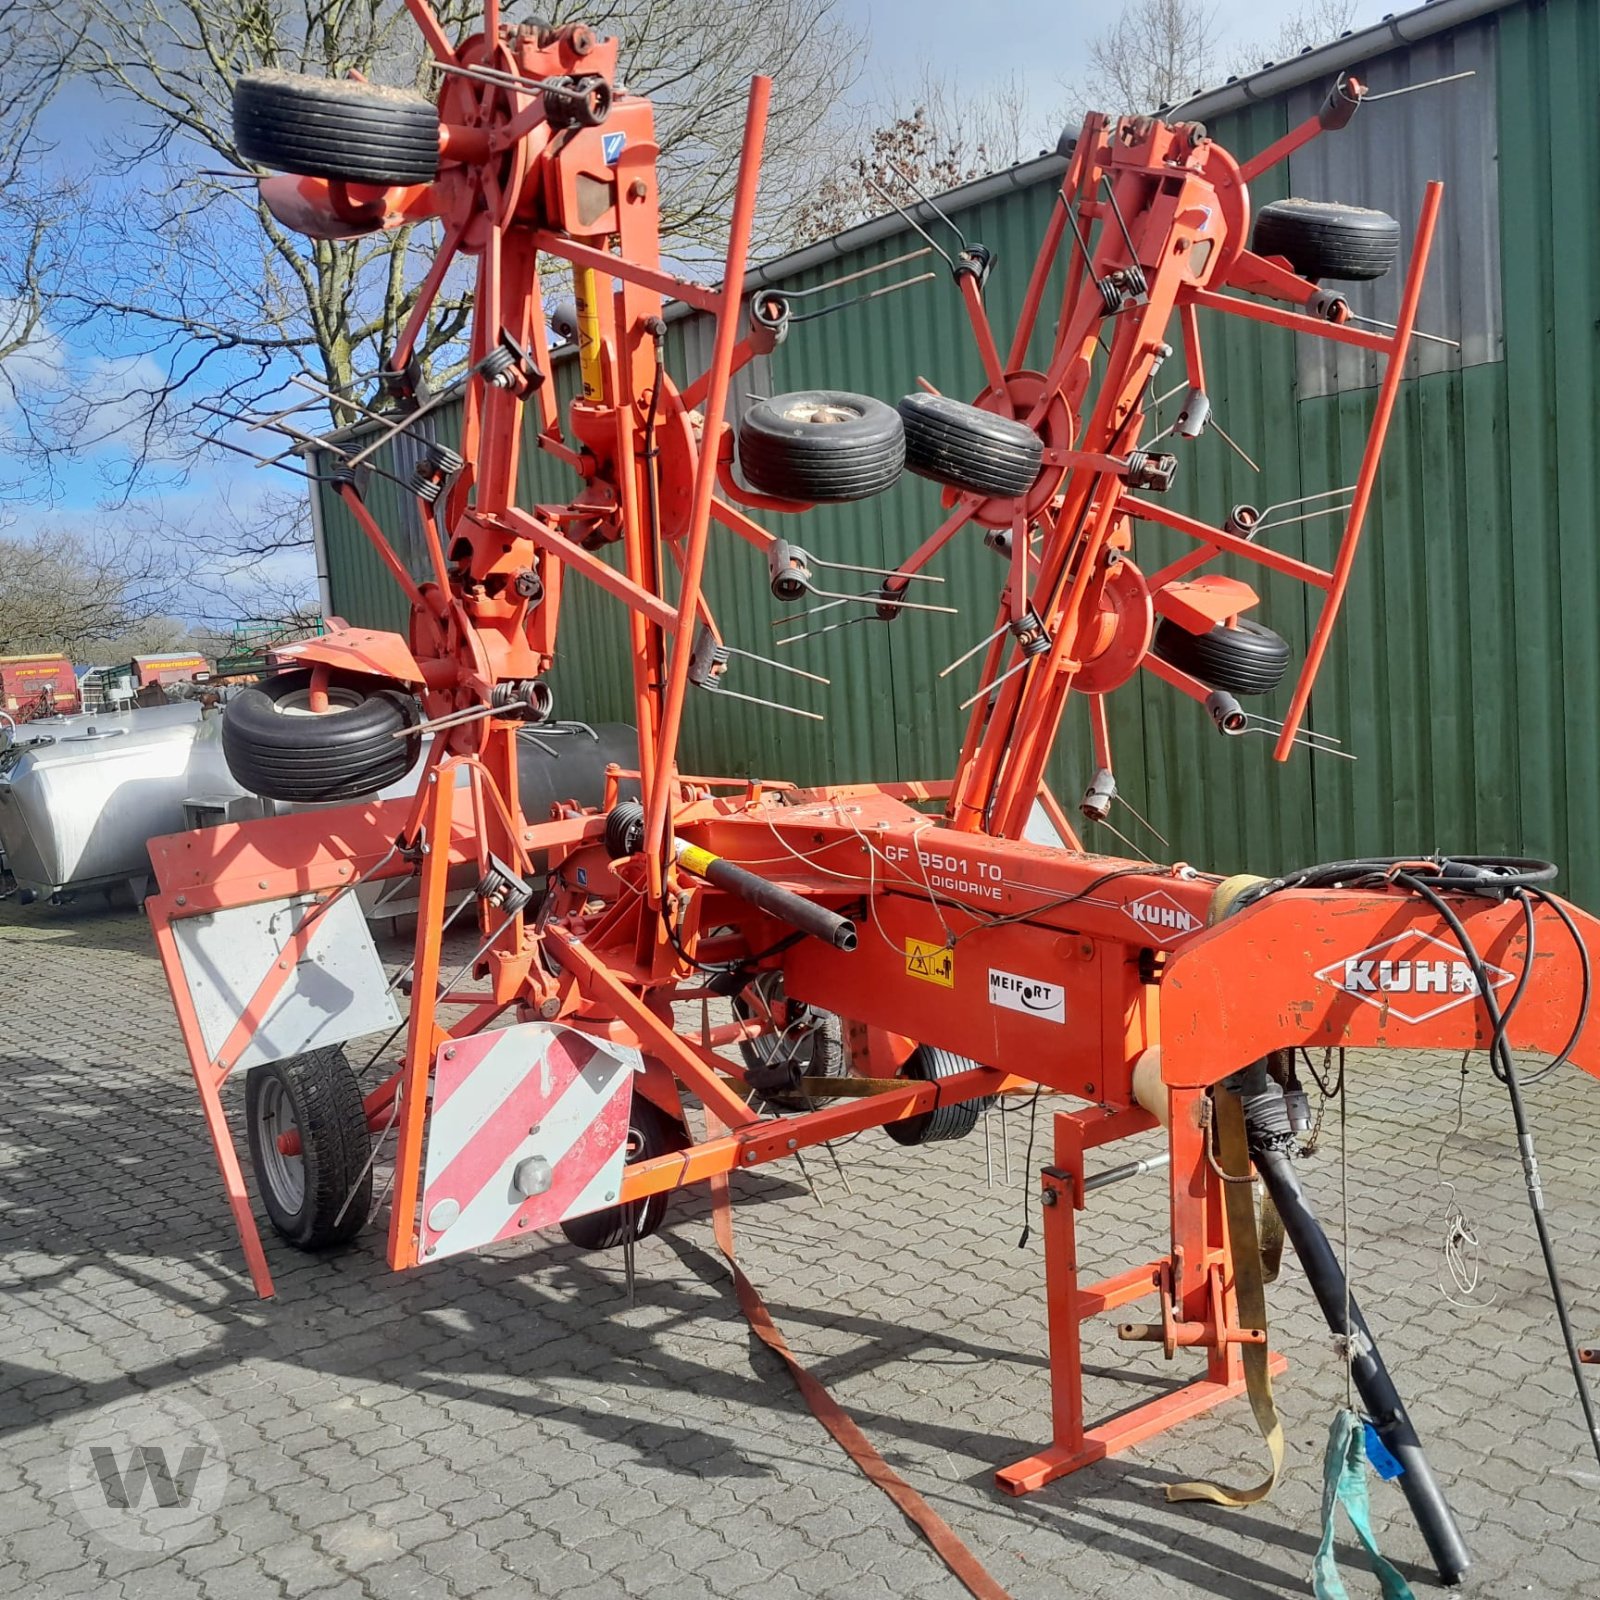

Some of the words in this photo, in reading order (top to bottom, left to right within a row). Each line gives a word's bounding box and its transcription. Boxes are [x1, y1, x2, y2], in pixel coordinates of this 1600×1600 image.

[886, 845, 910, 862] GF
[918, 851, 968, 875] 8501
[976, 862, 1002, 881] TO
[931, 875, 1002, 900] DIGIDRIVE
[1132, 902, 1191, 931] KUHN
[990, 974, 1052, 1001] MEIFORT
[1345, 960, 1482, 994] KUHN
